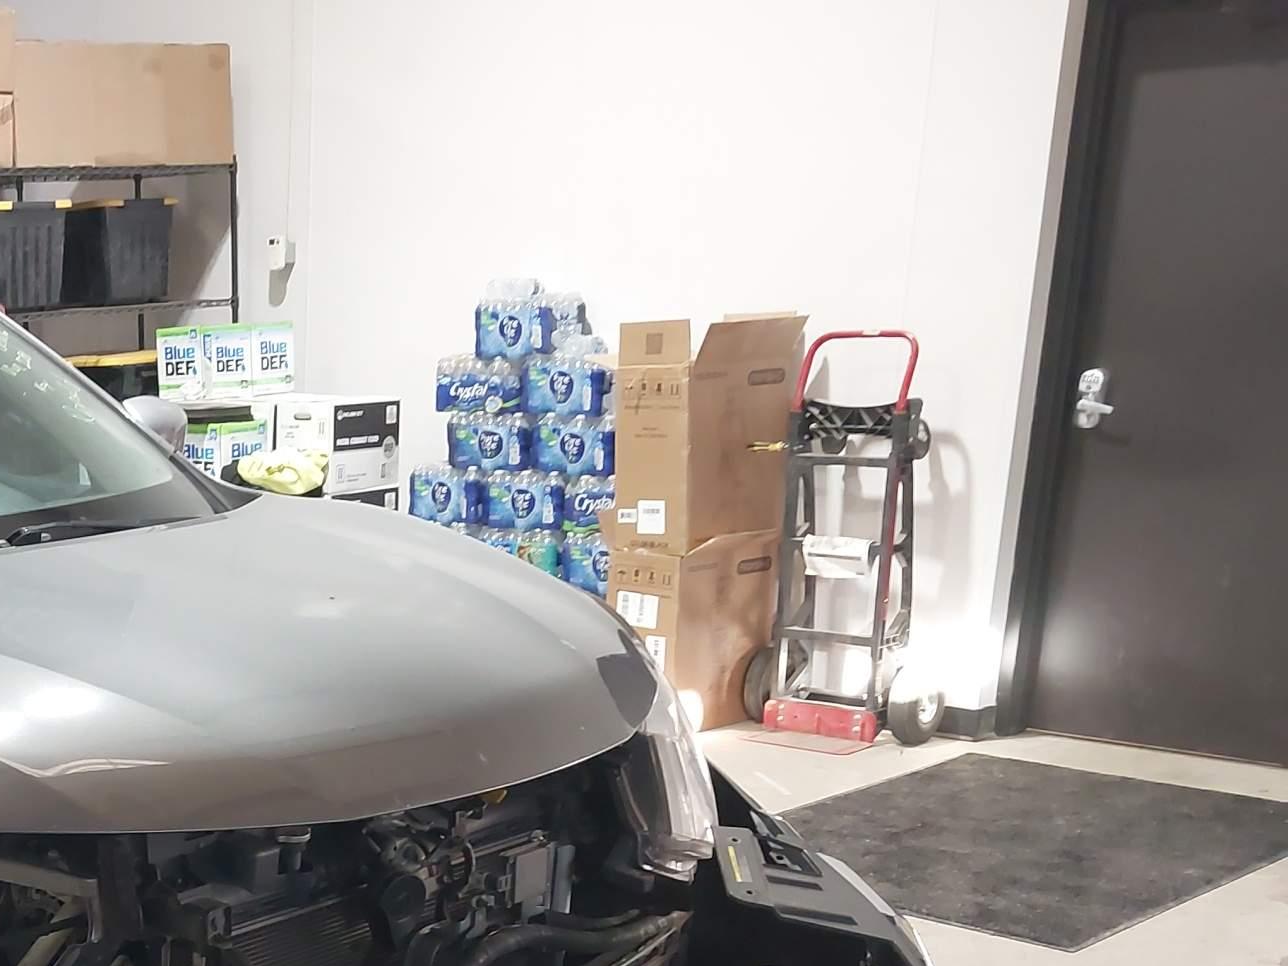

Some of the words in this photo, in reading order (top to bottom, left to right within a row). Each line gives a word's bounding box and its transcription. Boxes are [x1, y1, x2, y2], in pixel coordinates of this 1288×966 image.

[164, 346, 195, 360] Blue
[216, 346, 244, 358] Blue
[260, 341, 287, 355] Blue
[165, 360, 196, 376] DEF
[216, 358, 243, 372] DEF
[261, 355, 288, 370] DEF
[449, 382, 489, 403] Crystal
[183, 443, 214, 460] Blue
